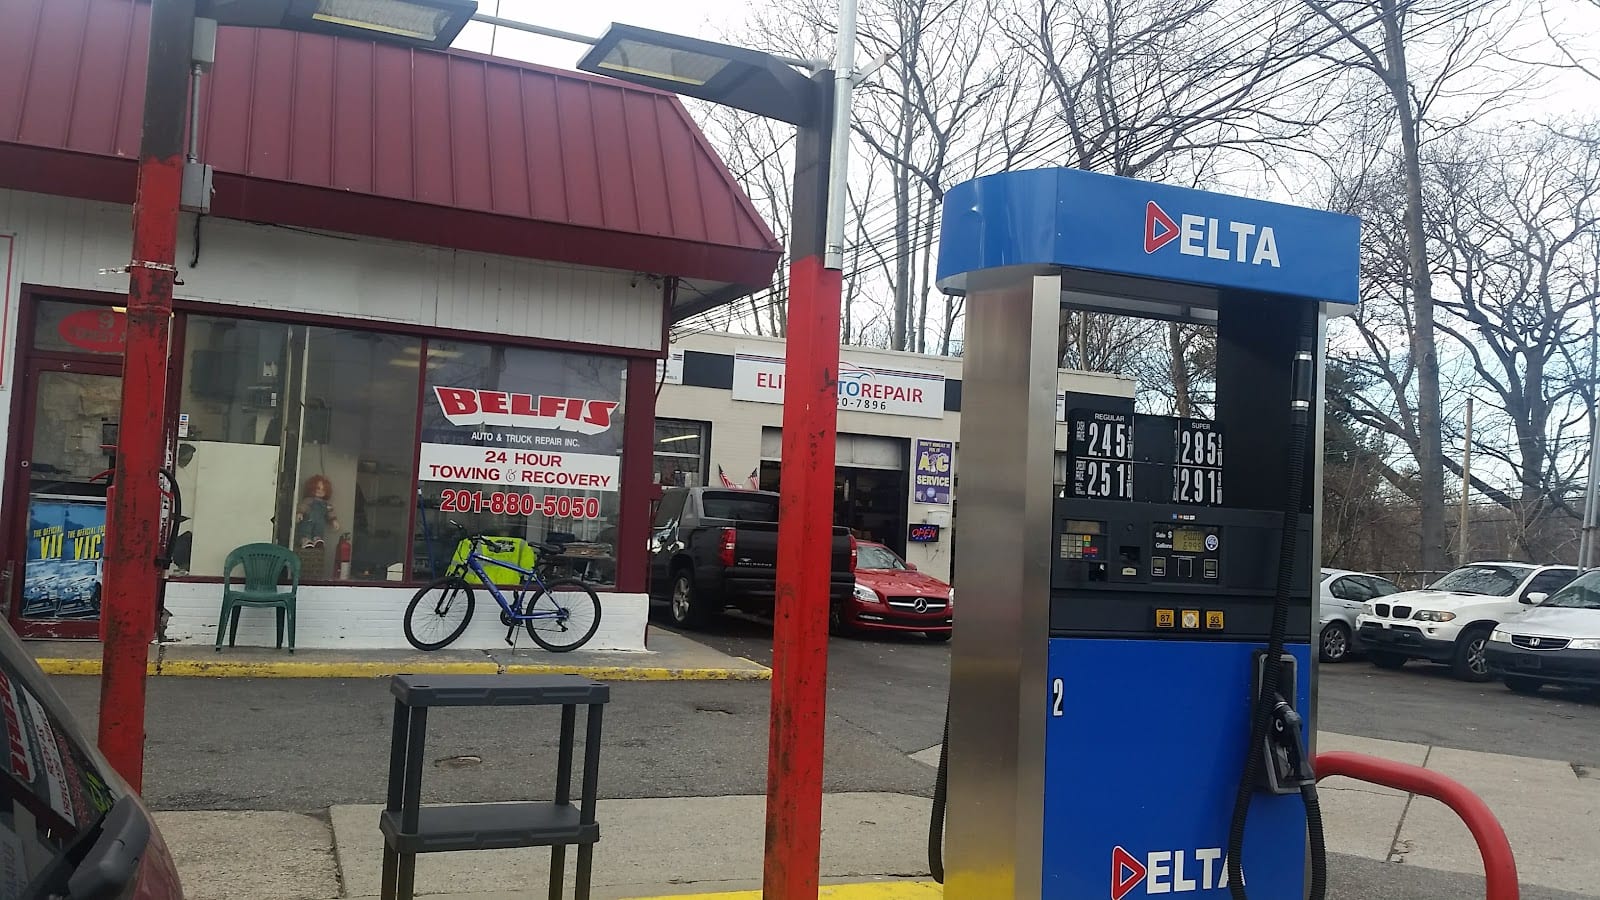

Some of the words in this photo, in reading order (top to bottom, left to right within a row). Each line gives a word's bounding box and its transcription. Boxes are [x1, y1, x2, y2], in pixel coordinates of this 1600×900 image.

[1144, 200, 1281, 268] DELTA
[757, 372, 786, 389] ELI
[838, 381, 923, 403] TOREPAIR
[433, 385, 620, 435] BELFIS
[838, 397, 887, 410] 0-7896
[1094, 412, 1125, 422] REGULAR
[471, 431, 494, 441] AUTO
[496, 433, 502, 442] &
[505, 433, 532, 444] TRUCK
[535, 436, 562, 446] REPAIR
[564, 438, 580, 447] INC.
[1088, 422, 1126, 457] 2.45
[1191, 422, 1211, 430] SUPER
[485, 450, 507, 464] 24
[514, 452, 562, 468] HOUR
[1181, 430, 1217, 465] 2.85
[429, 464, 501, 481] TOWING
[505, 468, 517, 483] &
[521, 470, 611, 488] RECOVERY
[916, 474, 950, 487] SERVICE
[1088, 461, 1125, 497] 2.51
[1181, 468, 1215, 503] 2.91
[440, 489, 600, 519] 201-880-5050
[74, 533, 105, 561] VIC
[911, 528, 937, 538] OPEN
[1160, 614, 1170, 623] 87
[1053, 678, 1063, 717] 2
